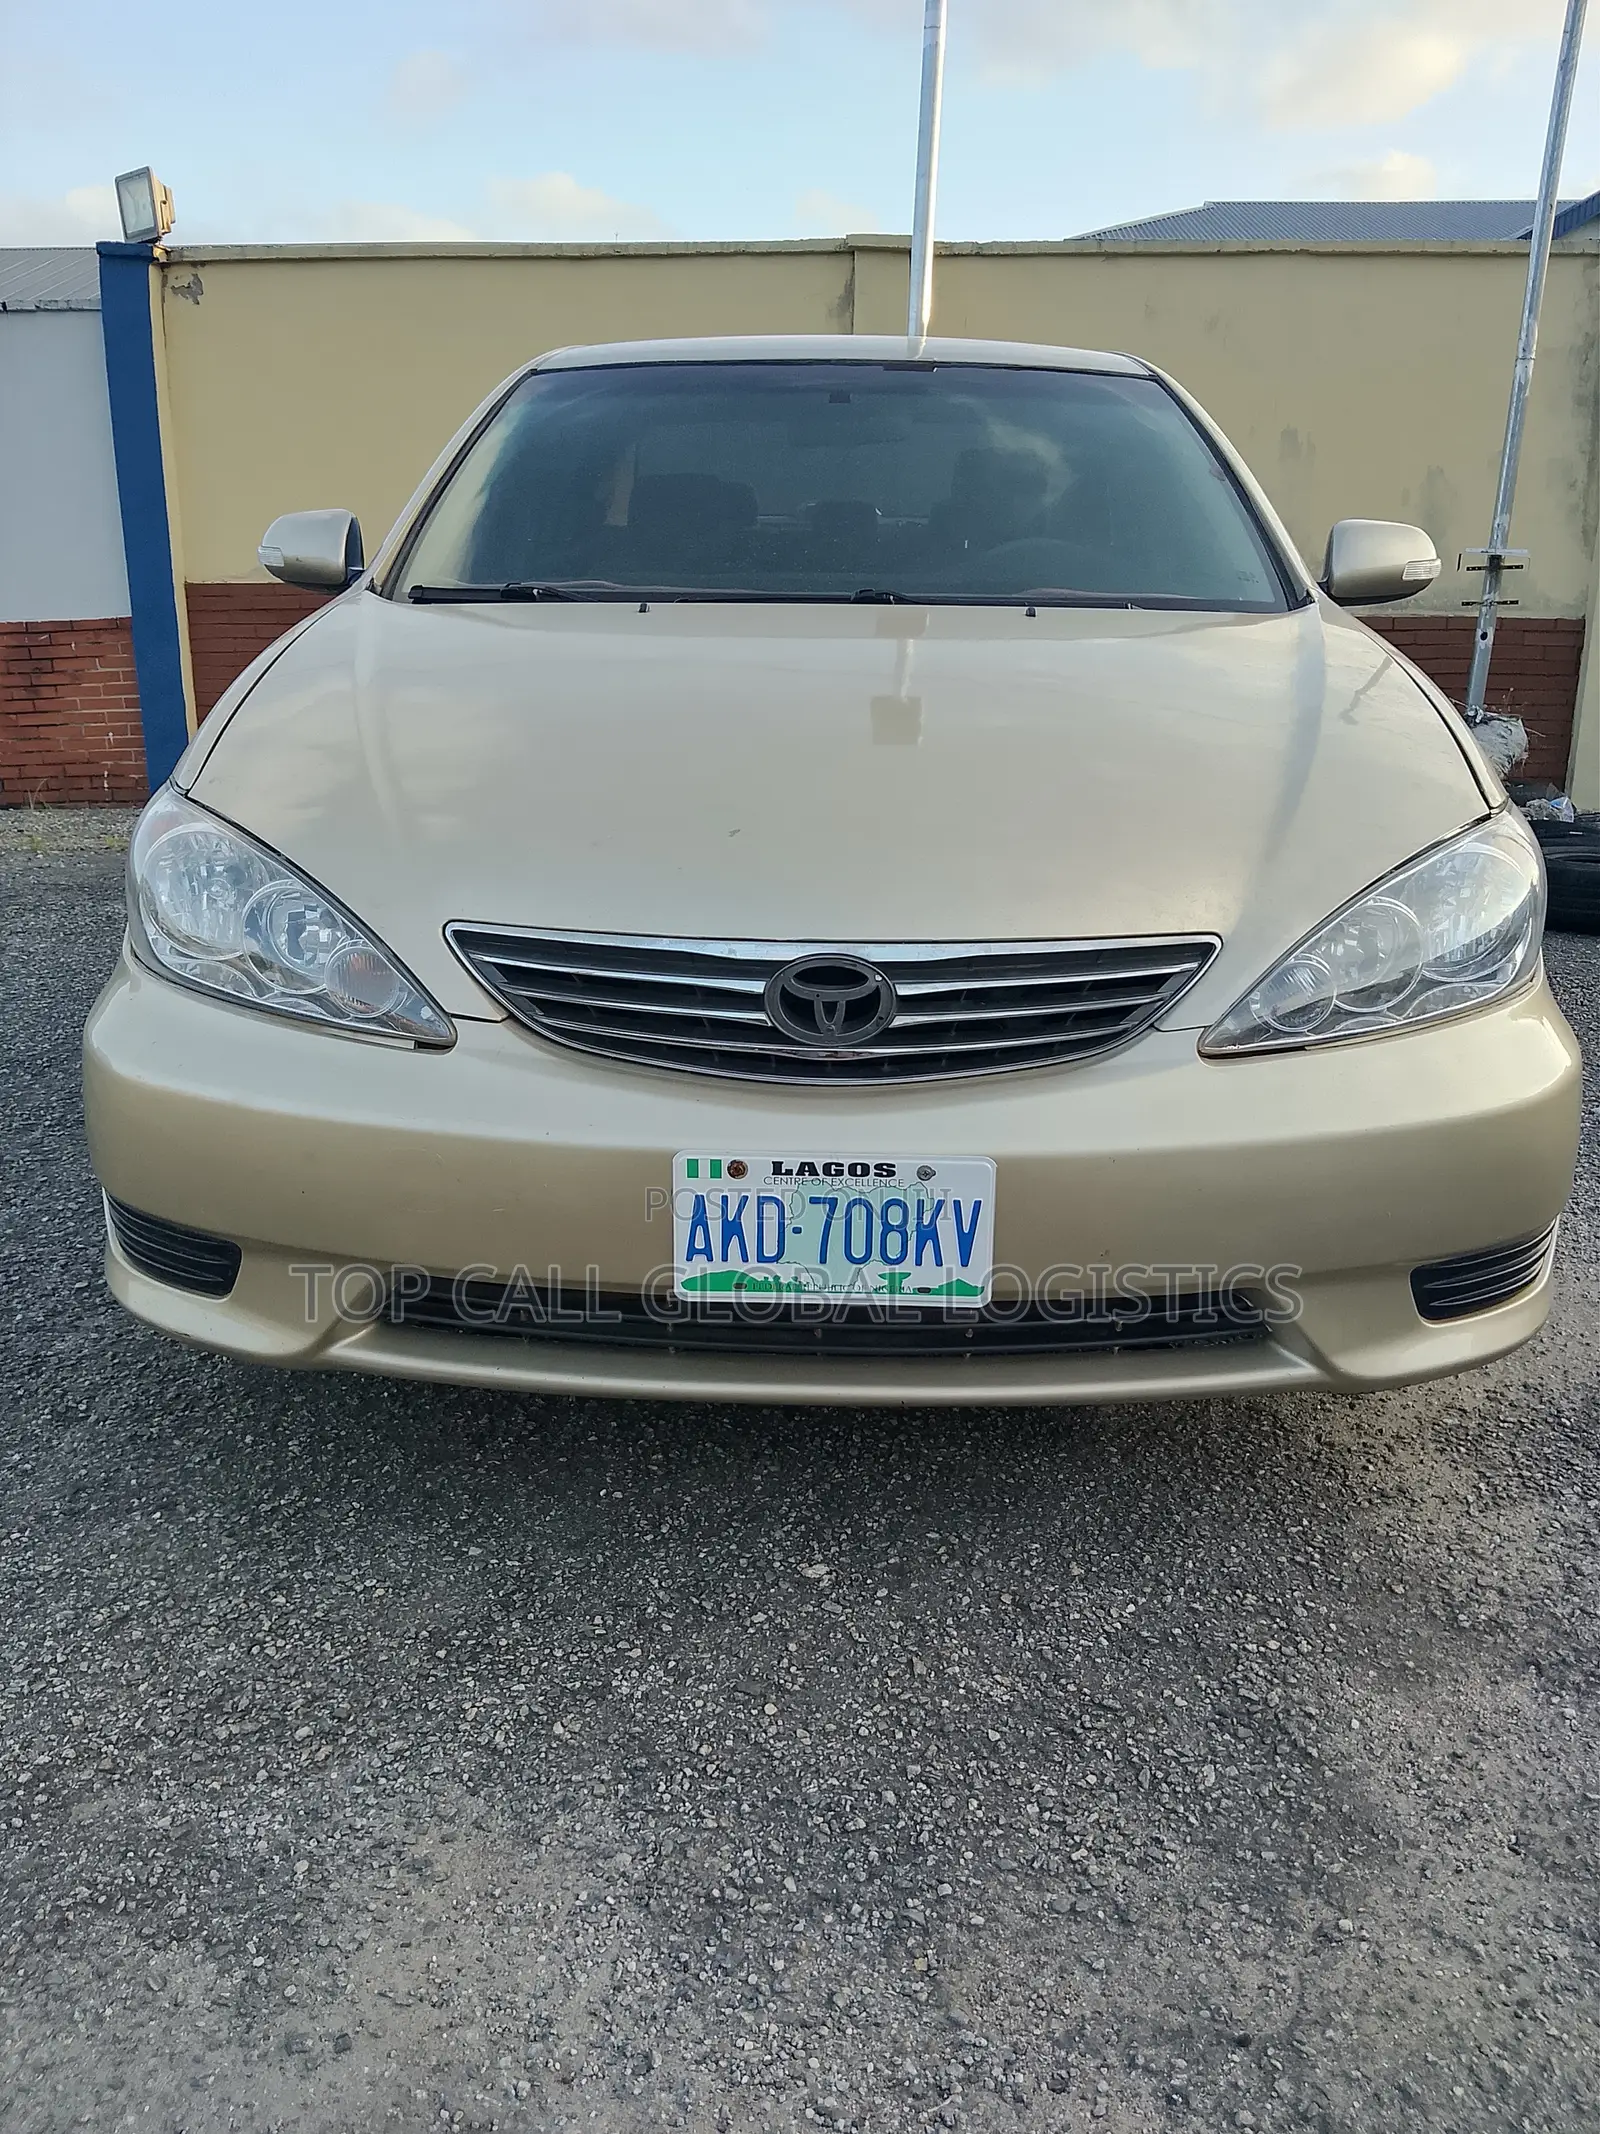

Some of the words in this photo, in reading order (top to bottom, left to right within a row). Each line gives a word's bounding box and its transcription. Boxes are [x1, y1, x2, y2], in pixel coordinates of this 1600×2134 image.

[771, 1160, 897, 1178] LAGOS
[763, 1176, 808, 1186] CENTRE
[811, 1177, 829, 1187] OF
[830, 1177, 905, 1188] EXCELLENCE
[685, 1194, 983, 1268] AKD-708KV
